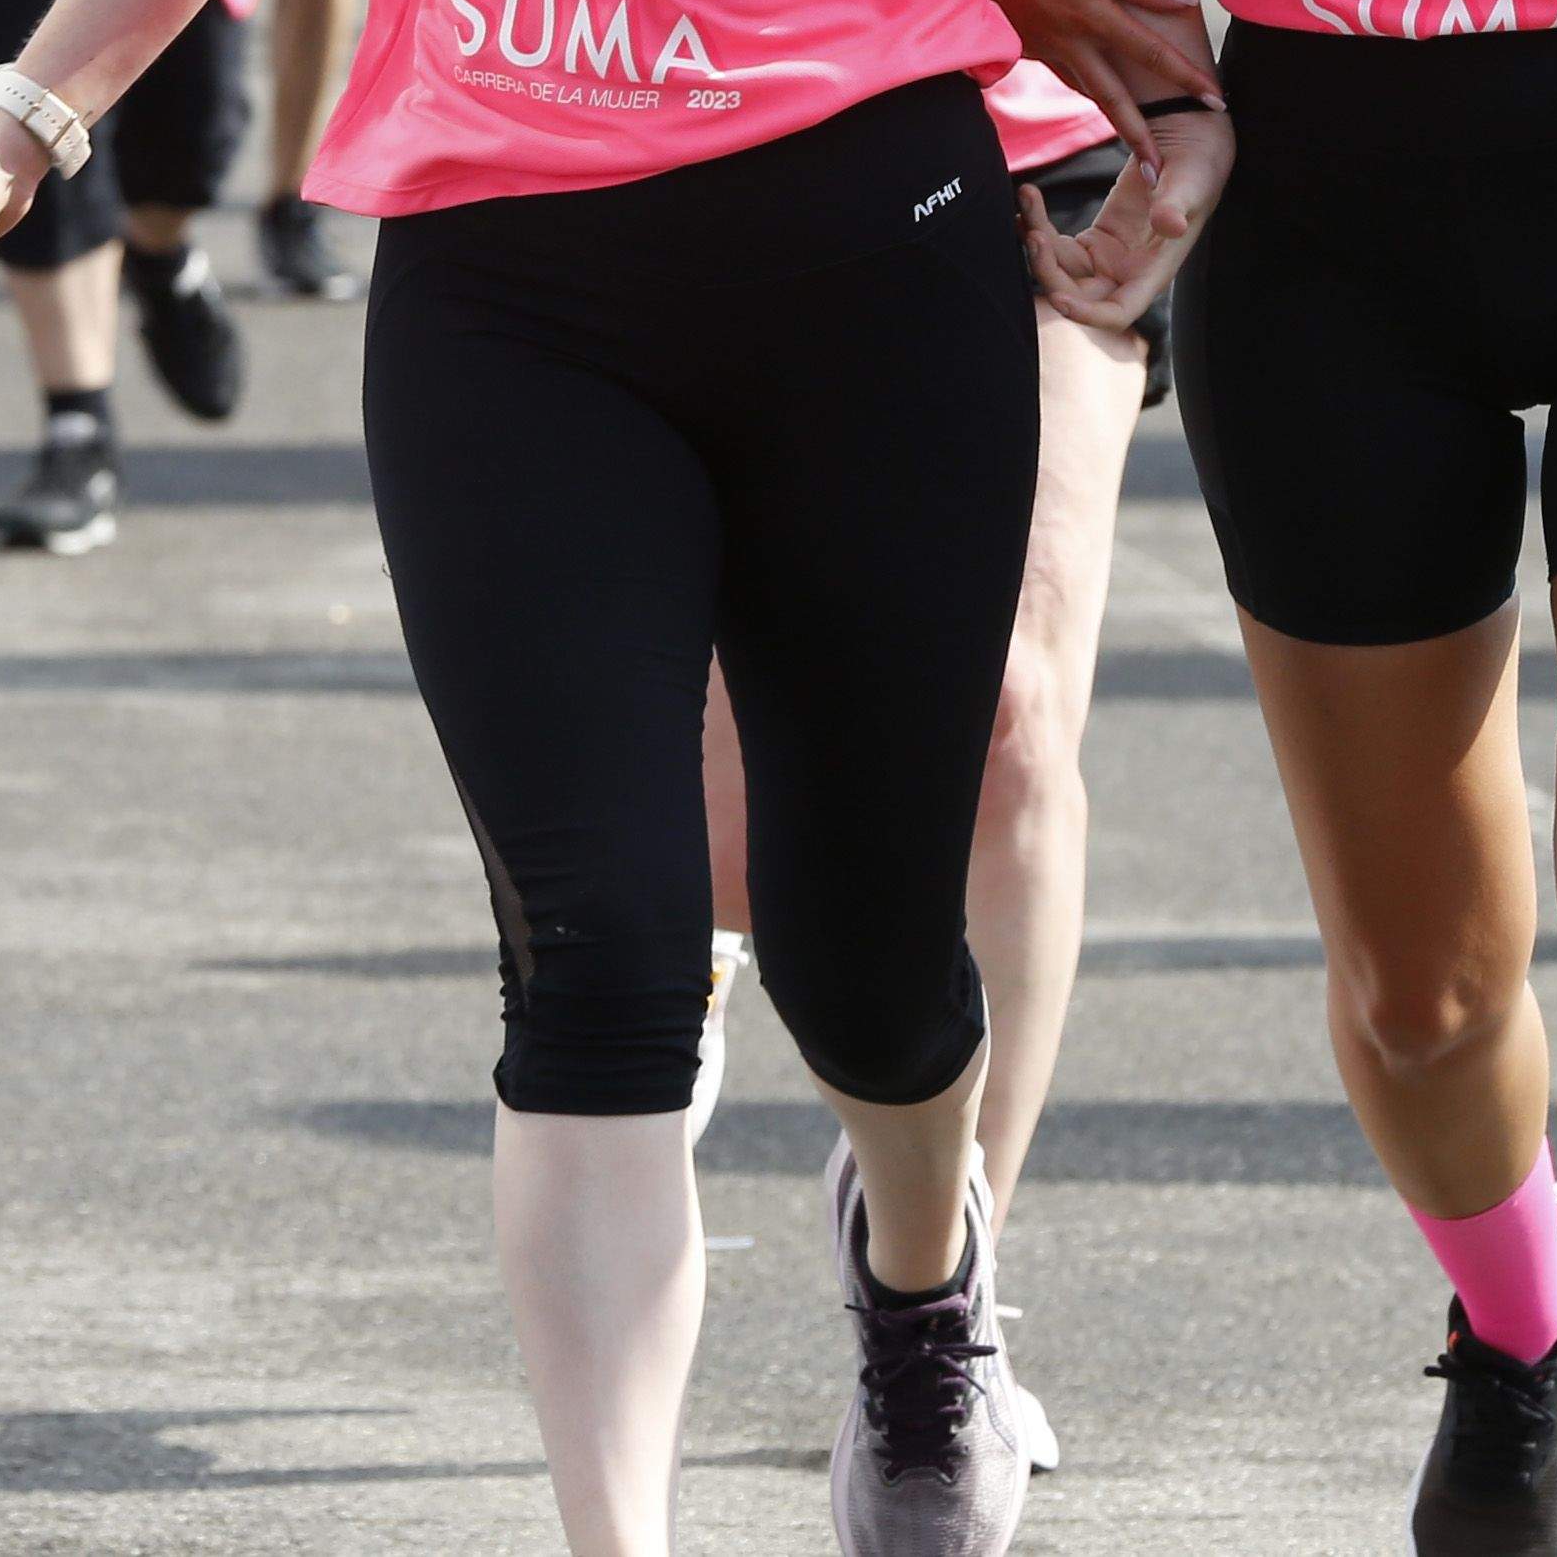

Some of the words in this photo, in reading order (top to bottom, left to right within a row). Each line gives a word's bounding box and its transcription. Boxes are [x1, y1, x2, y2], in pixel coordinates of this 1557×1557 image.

[453, 65, 527, 96] CARRERA
[530, 82, 555, 102] DE
[557, 85, 582, 105] LA
[588, 89, 659, 109] MUJER
[686, 89, 741, 110] 2023
